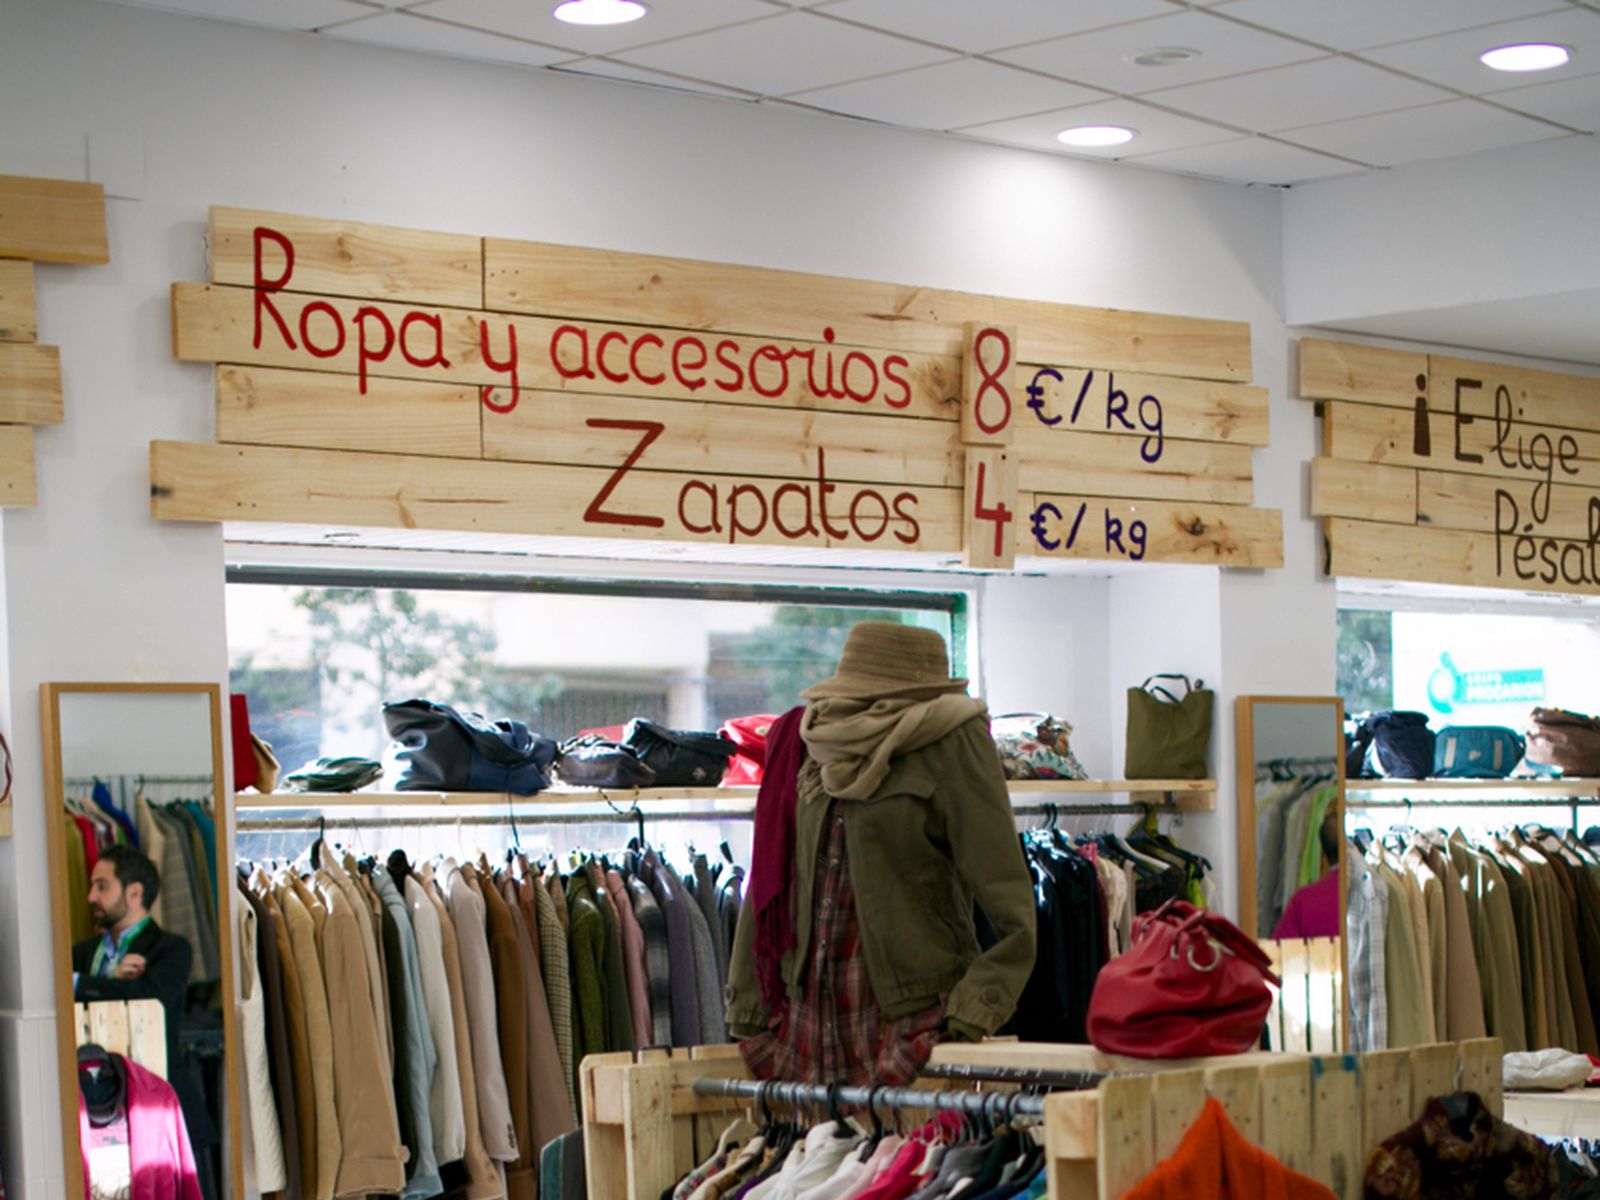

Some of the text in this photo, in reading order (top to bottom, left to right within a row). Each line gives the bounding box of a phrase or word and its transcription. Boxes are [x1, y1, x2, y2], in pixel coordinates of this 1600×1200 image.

[252, 226, 451, 396] Ropa
[479, 319, 520, 414] y
[549, 324, 912, 409] accesorios
[974, 327, 1013, 435] 8
[583, 418, 921, 545] Zapatos
[974, 462, 1013, 557] 4
